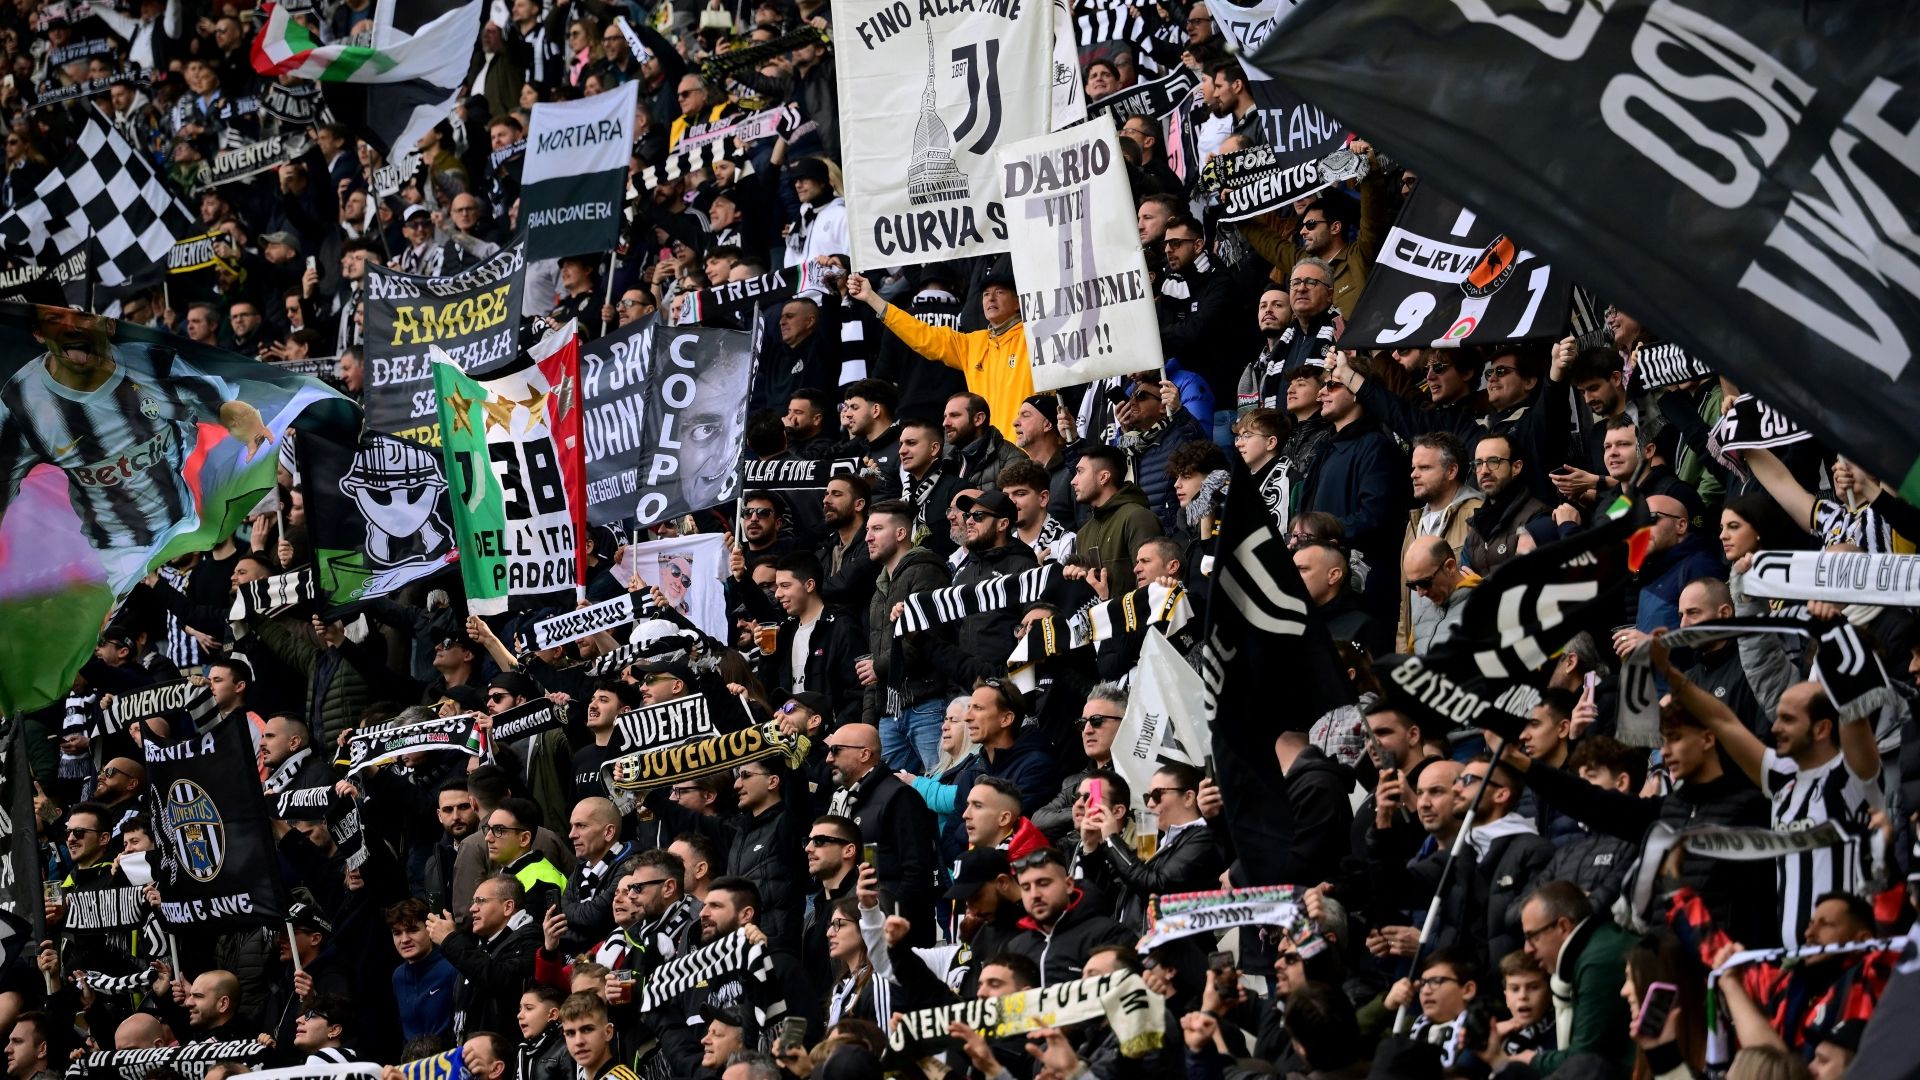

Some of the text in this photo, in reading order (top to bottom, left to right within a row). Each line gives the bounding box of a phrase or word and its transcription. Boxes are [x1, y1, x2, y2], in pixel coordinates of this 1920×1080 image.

[856, 1, 912, 50] FINO
[951, 62, 968, 79] 1897
[1115, 91, 1156, 128] FINE
[212, 135, 282, 175] JUVENTUS
[536, 117, 623, 155] MORTARA
[1003, 138, 1111, 199] DARIO
[1226, 158, 1318, 214] JUVENTUS
[527, 199, 612, 230] BIANCONERA
[1044, 189, 1084, 228] VIVE
[873, 203, 985, 257] CURVA
[369, 241, 525, 300] MIO GRANDE
[711, 269, 787, 305] TREIA
[1053, 268, 1145, 318] INSIEME
[390, 284, 511, 346] AMORE
[1051, 328, 1090, 364] NOI
[778, 459, 817, 481] FINE
[493, 558, 578, 591] PADRON
[541, 600, 627, 646] JUVENTUS
[121, 683, 186, 723] JUVENTUS
[614, 696, 714, 752] JUVENTU
[642, 724, 763, 779] JUVENTUS
[170, 799, 214, 824] JUVENTUS
[289, 785, 330, 806] JUVENTUS
[65, 892, 100, 929] BLACK
[99, 888, 118, 927] AND
[210, 893, 254, 919] JUVE
[888, 996, 998, 1051] UVENTUS
[111, 1047, 178, 1066] PADRE
